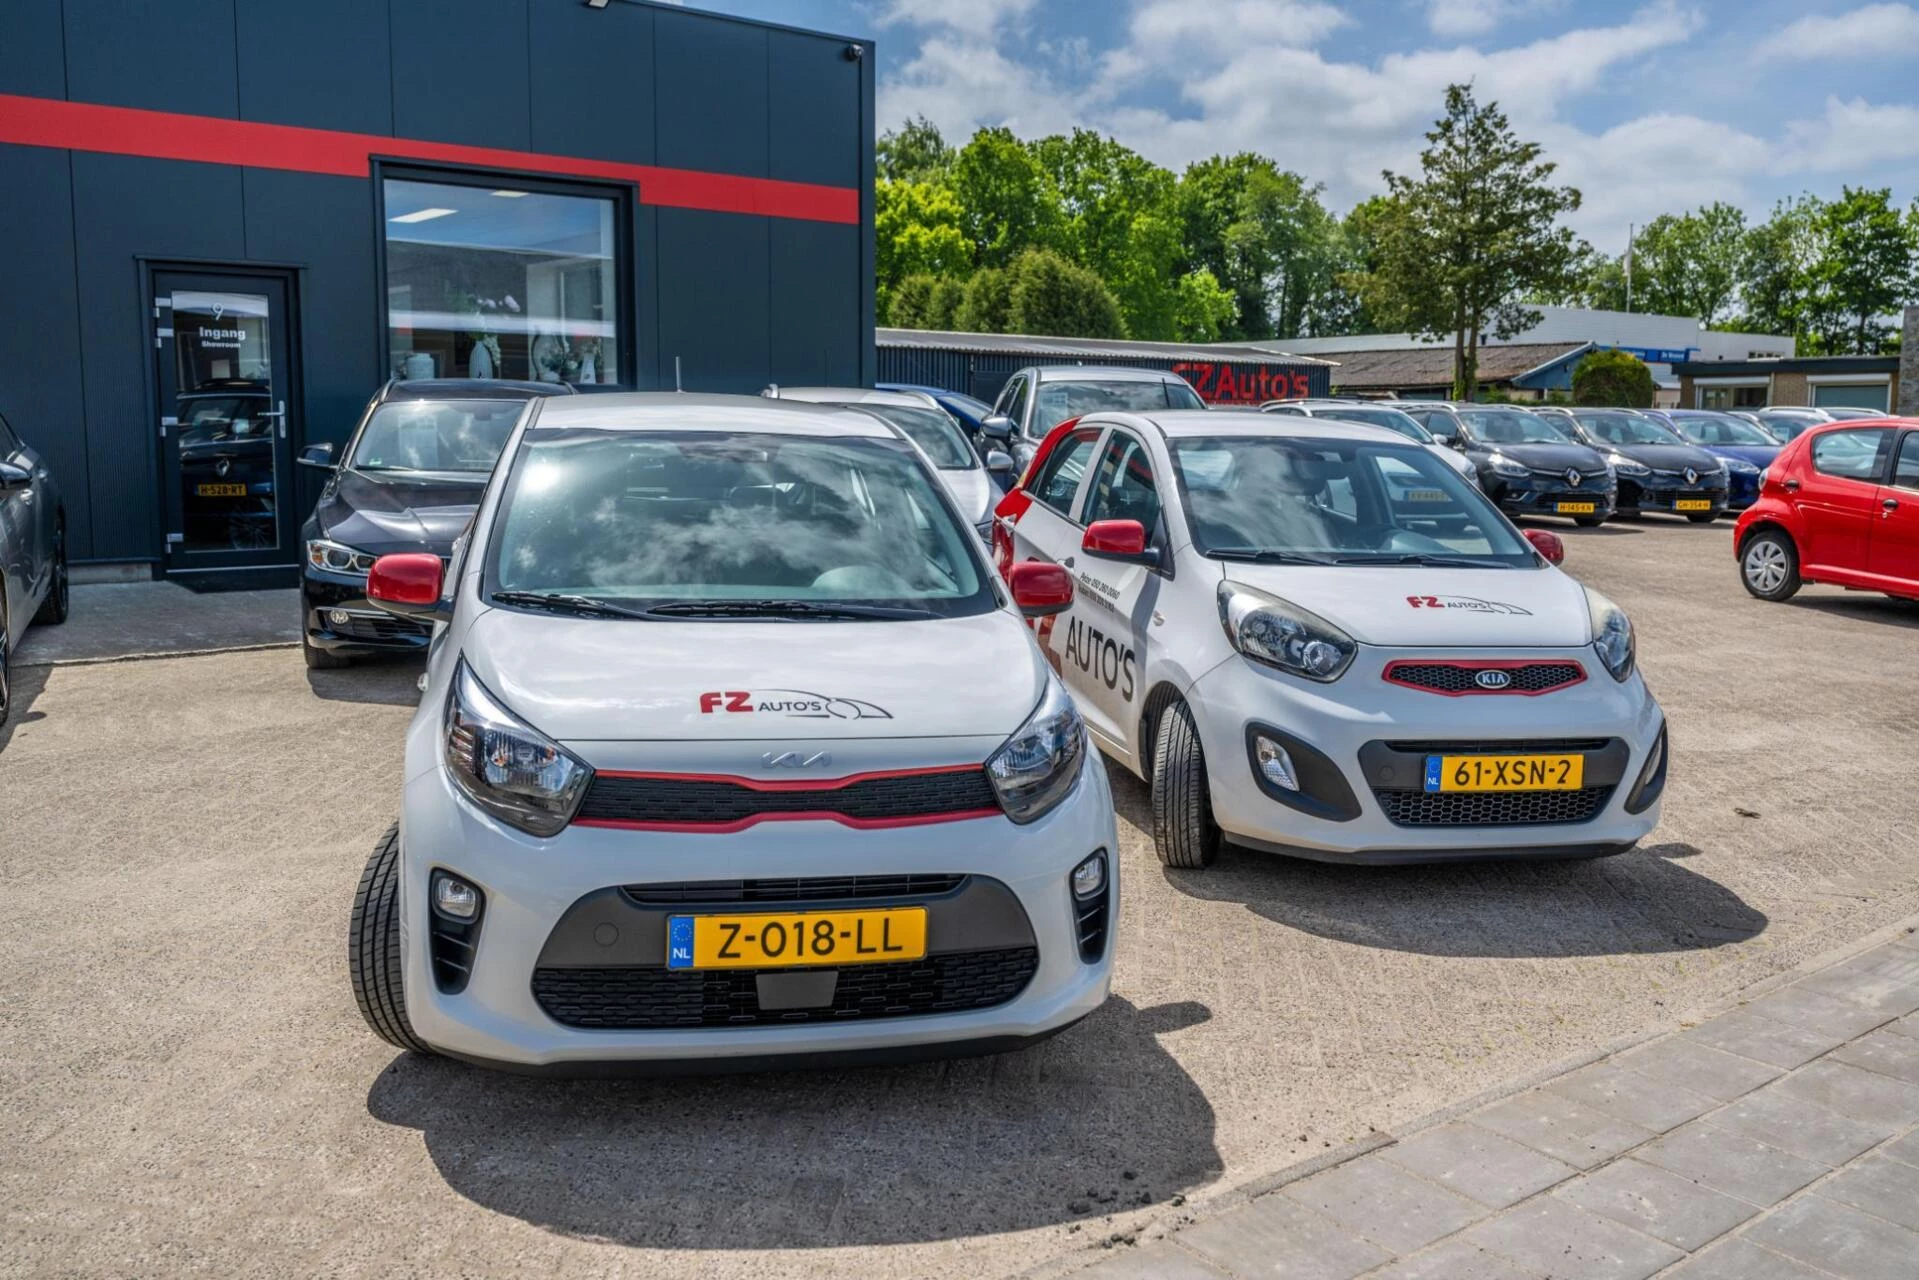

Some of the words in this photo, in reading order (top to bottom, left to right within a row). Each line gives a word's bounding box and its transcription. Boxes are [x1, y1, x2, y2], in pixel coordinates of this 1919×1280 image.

[212, 302, 223, 320] 9
[199, 326, 246, 340] Ingang
[201, 340, 241, 348] Showroom
[1406, 596, 1445, 608] FZ
[1065, 616, 1136, 703] AUTO'S
[1481, 674, 1506, 684] KIA
[699, 691, 754, 714] FZ
[758, 701, 822, 712] AUTO'S
[1427, 777, 1439, 786] NL
[1454, 759, 1571, 786] 61-XSN-2
[673, 947, 691, 959] NL
[717, 917, 903, 959] Z-018-LL
